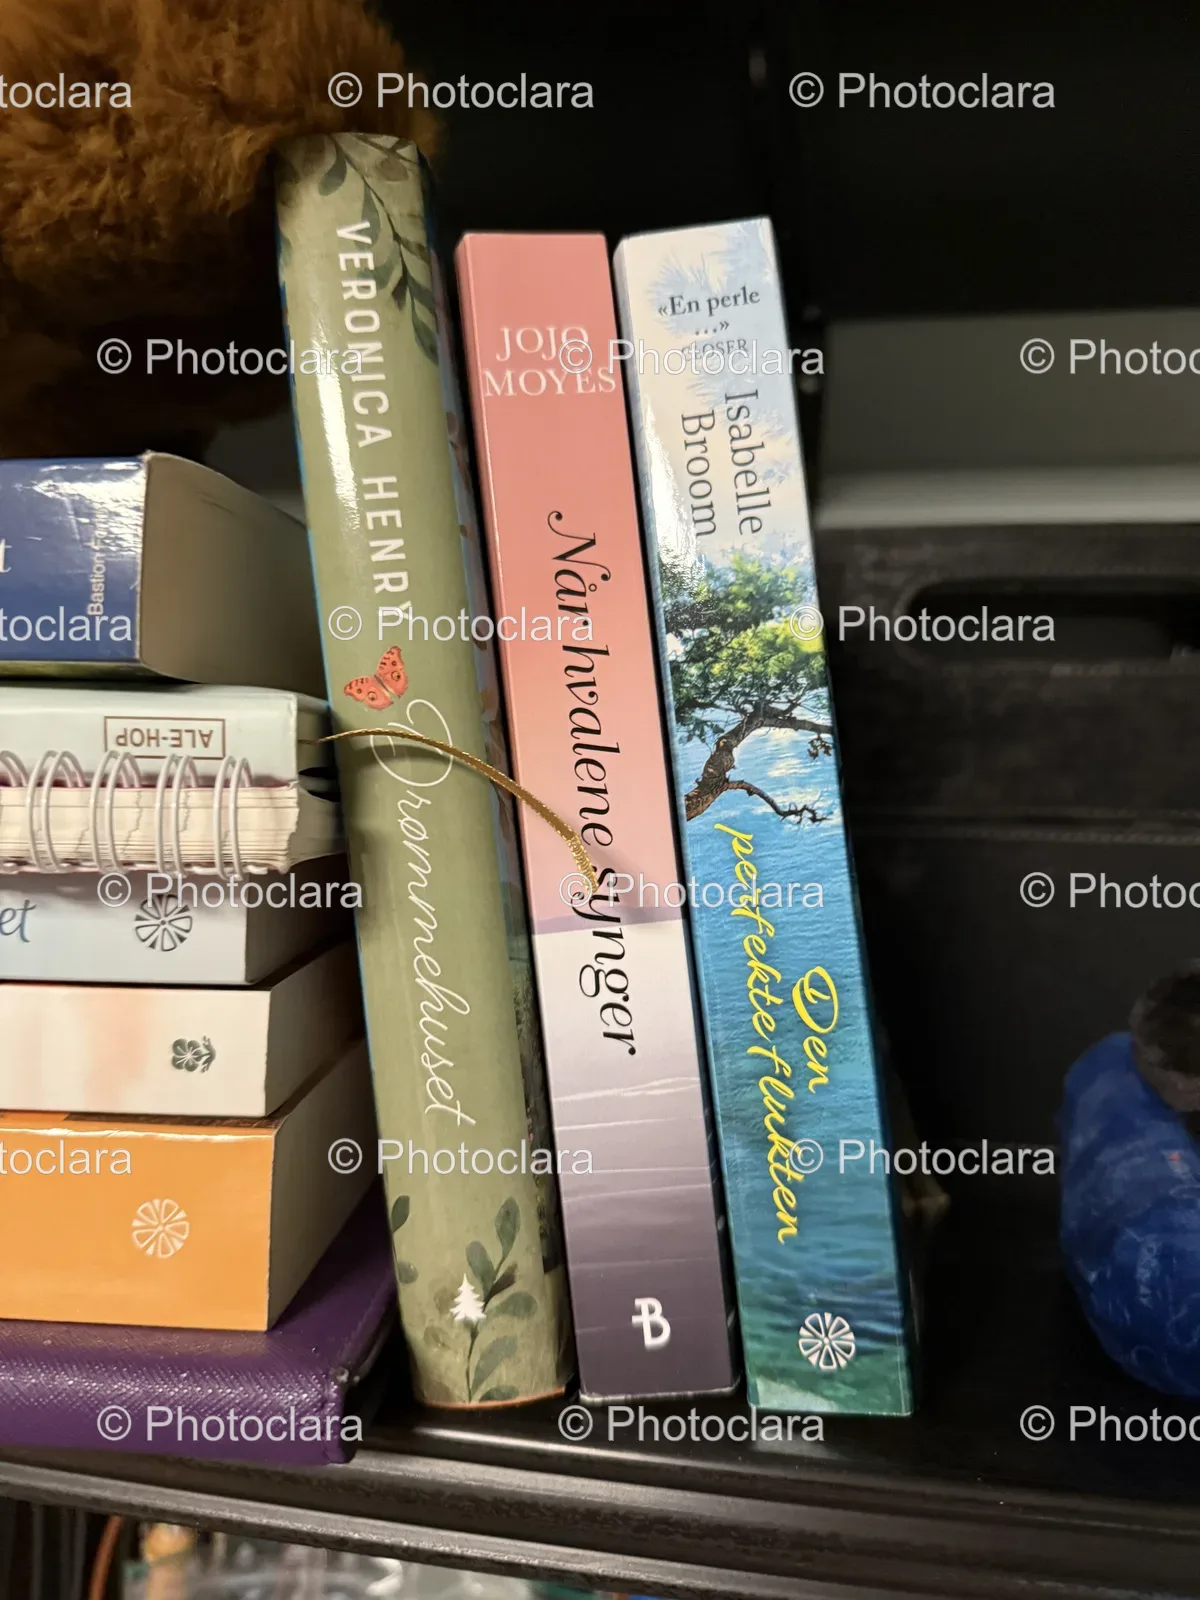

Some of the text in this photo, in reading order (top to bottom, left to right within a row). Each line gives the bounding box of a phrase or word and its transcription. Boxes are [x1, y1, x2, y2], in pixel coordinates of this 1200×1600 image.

[496, 326, 590, 362] JOJO
[706, 284, 761, 318] perle
[336, 220, 412, 622] VERONICA HENRY
[483, 367, 617, 398] MOYES
[681, 409, 717, 537] Broom
[724, 388, 772, 536] Isabelle
[86, 553, 107, 617] Bastion
[115, 726, 214, 749] ALE-HOP
[547, 510, 637, 1057] Når hvalene synger
[0, 899, 37, 943] et
[369, 698, 477, 1127] Drømmehuset
[713, 822, 805, 1246] perfekte flukten
[791, 965, 839, 1095] Den
